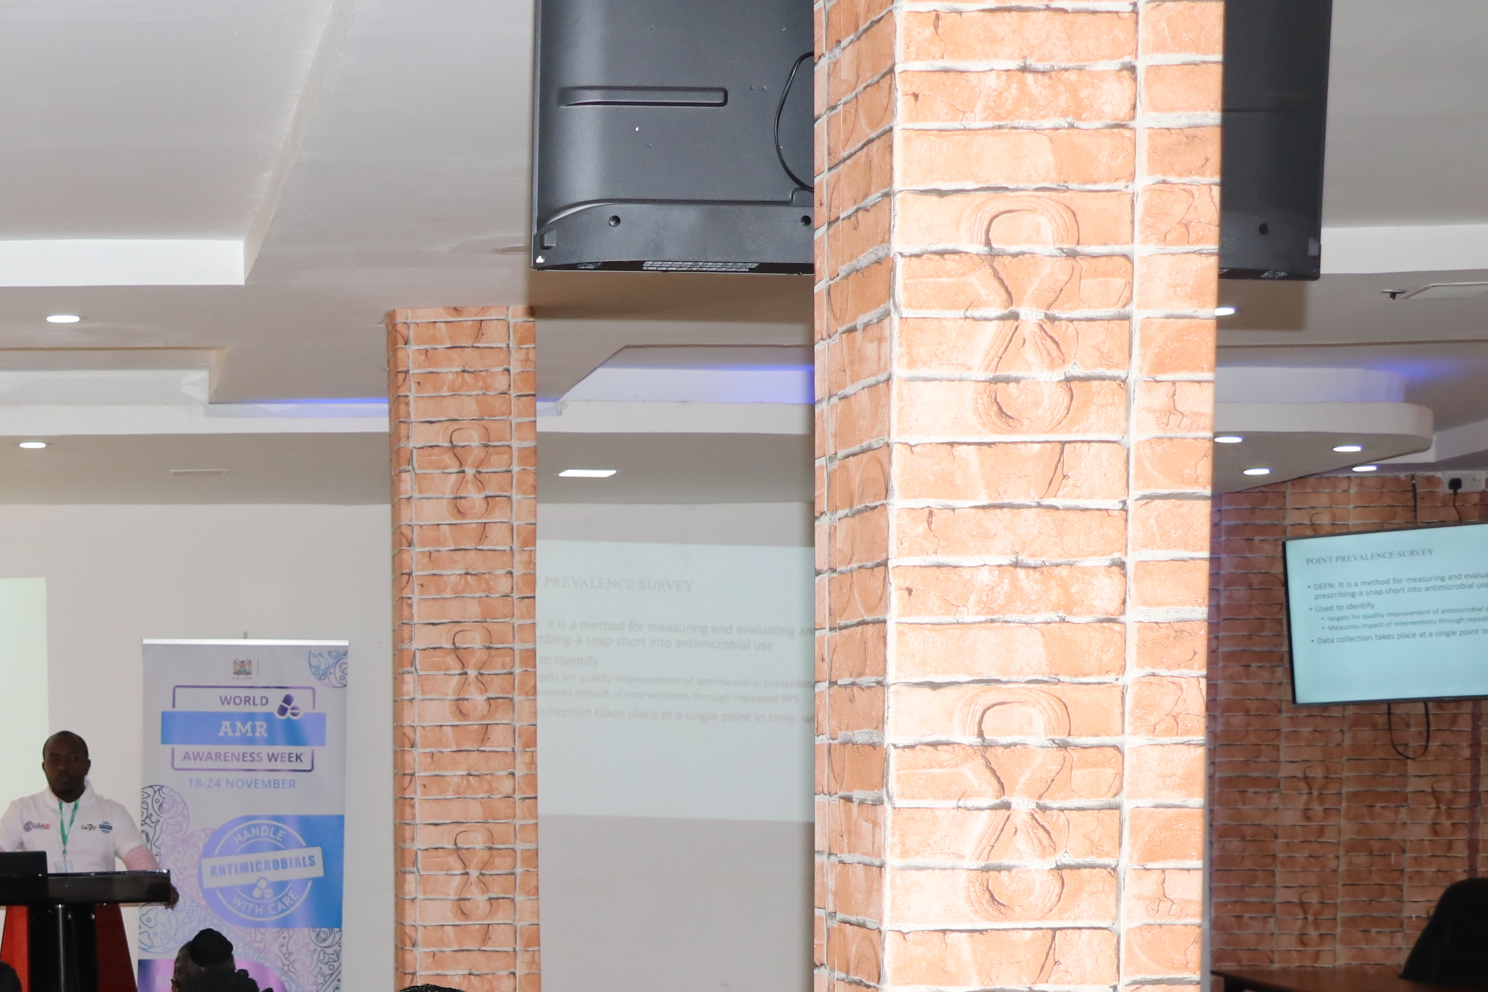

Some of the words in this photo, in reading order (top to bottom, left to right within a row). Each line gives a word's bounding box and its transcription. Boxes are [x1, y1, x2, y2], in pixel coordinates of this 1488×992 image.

[1306, 556, 1333, 565] POINT
[1336, 551, 1395, 563] PREVALENCE
[1397, 548, 1432, 558] SURVEY
[545, 576, 635, 589] PREVALENCE
[639, 579, 693, 592] SURVEY
[1315, 604, 1334, 612] Used
[1346, 601, 1375, 609] identify
[546, 619, 554, 629] It
[558, 619, 565, 629] is
[570, 621, 576, 629] a
[580, 620, 625, 631] method
[629, 620, 645, 632] for
[648, 622, 708, 635] measuring
[712, 623, 732, 634] and
[736, 625, 795, 637] evaluating
[586, 637, 612, 647] snap
[617, 636, 646, 647] short
[650, 637, 671, 648] into
[675, 638, 750, 649] antimicrobial
[754, 641, 773, 651] use
[540, 656, 550, 665] to
[555, 655, 598, 668] identify
[220, 695, 269, 706] WORLD
[595, 708, 624, 719] takes
[628, 709, 657, 720] place
[662, 711, 671, 720] at
[676, 712, 682, 720] a
[686, 711, 717, 723] single
[722, 713, 751, 723] point
[755, 713, 765, 722] in
[218, 721, 267, 736] AMR
[183, 752, 262, 762] AWARENESS
[267, 752, 303, 762] WEEK
[188, 778, 221, 788] 18-24
[226, 779, 296, 789] NOVEMBER
[233, 826, 286, 844] HANDLE
[210, 855, 316, 876] ANTIMICROBIALS
[233, 896, 263, 915] WITH
[268, 891, 298, 914] CARE
